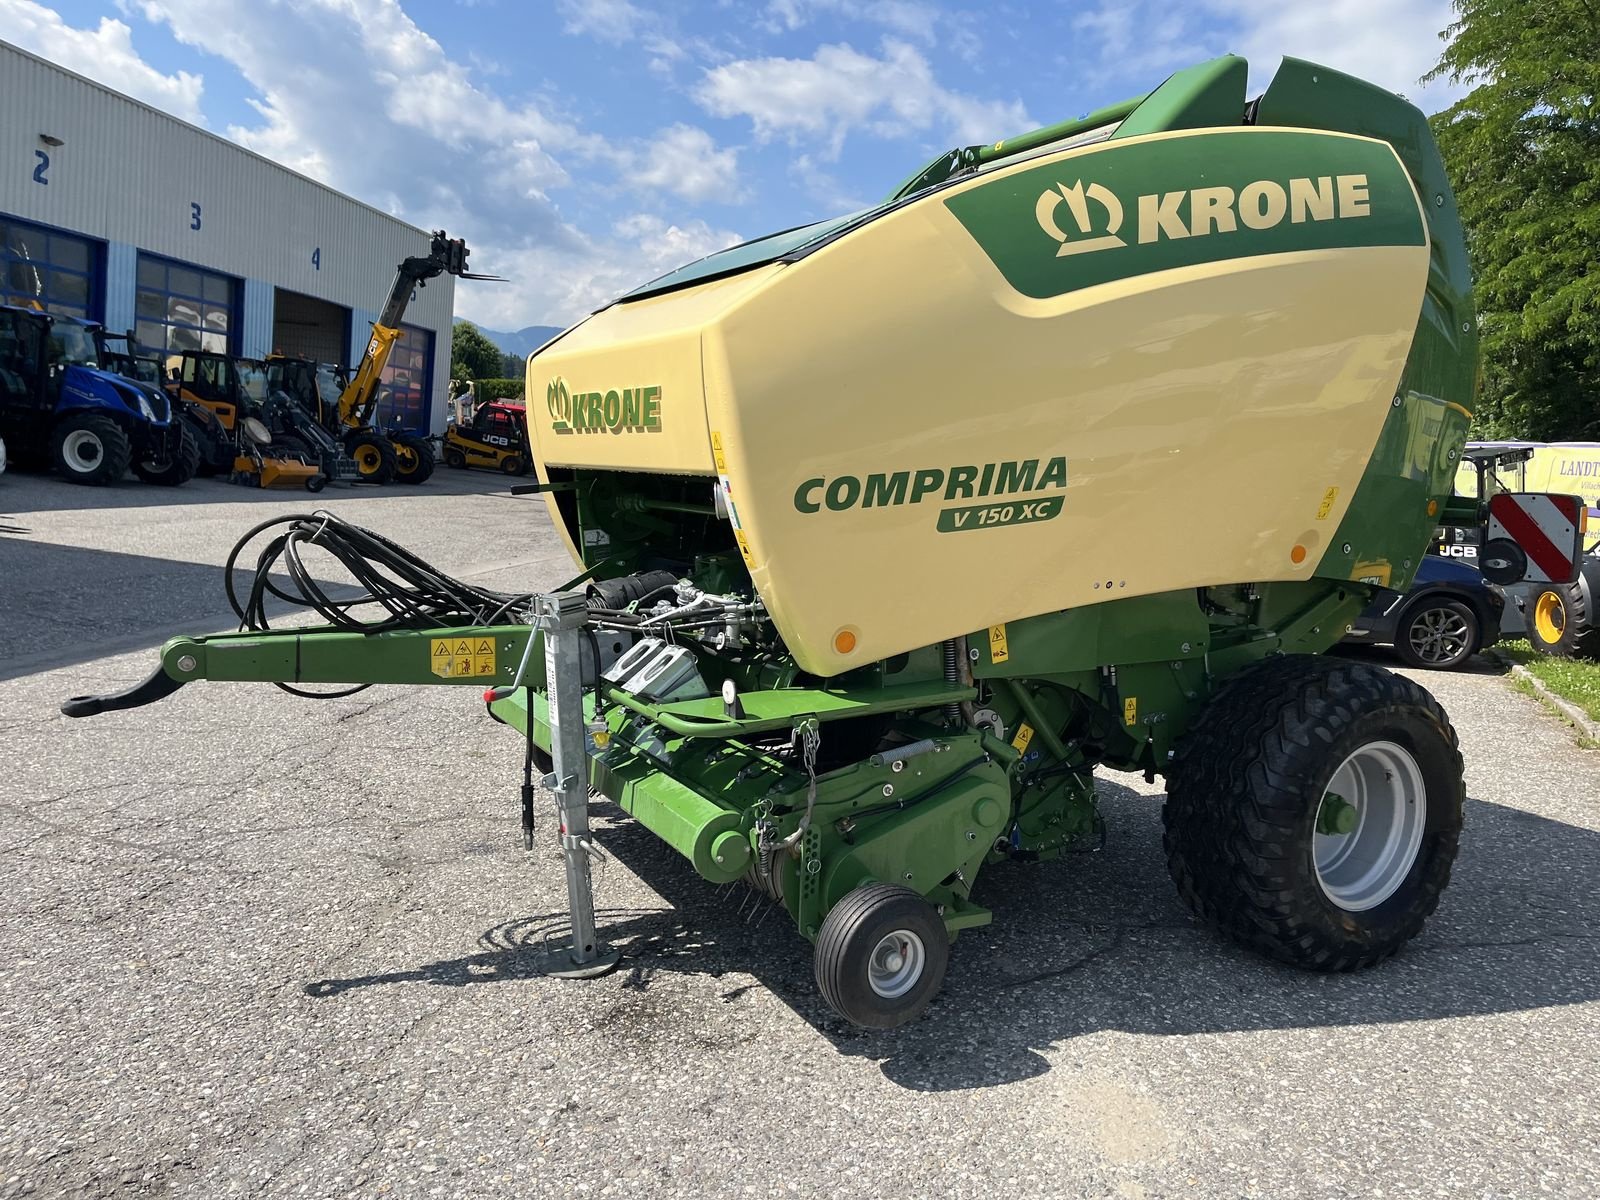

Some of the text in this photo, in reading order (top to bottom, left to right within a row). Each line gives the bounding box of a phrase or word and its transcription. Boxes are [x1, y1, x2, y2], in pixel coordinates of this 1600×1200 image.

[33, 149, 49, 185] 2
[191, 201, 201, 230] 3
[1138, 174, 1371, 244] KRONE
[311, 247, 320, 270] 4
[572, 386, 661, 432] KRONE
[482, 434, 508, 446] JCB
[1560, 460, 1600, 477] LANDT
[793, 456, 1067, 514] COMPRIMA
[953, 502, 1051, 528] V 150 XC
[1439, 545, 1477, 557] JCB
